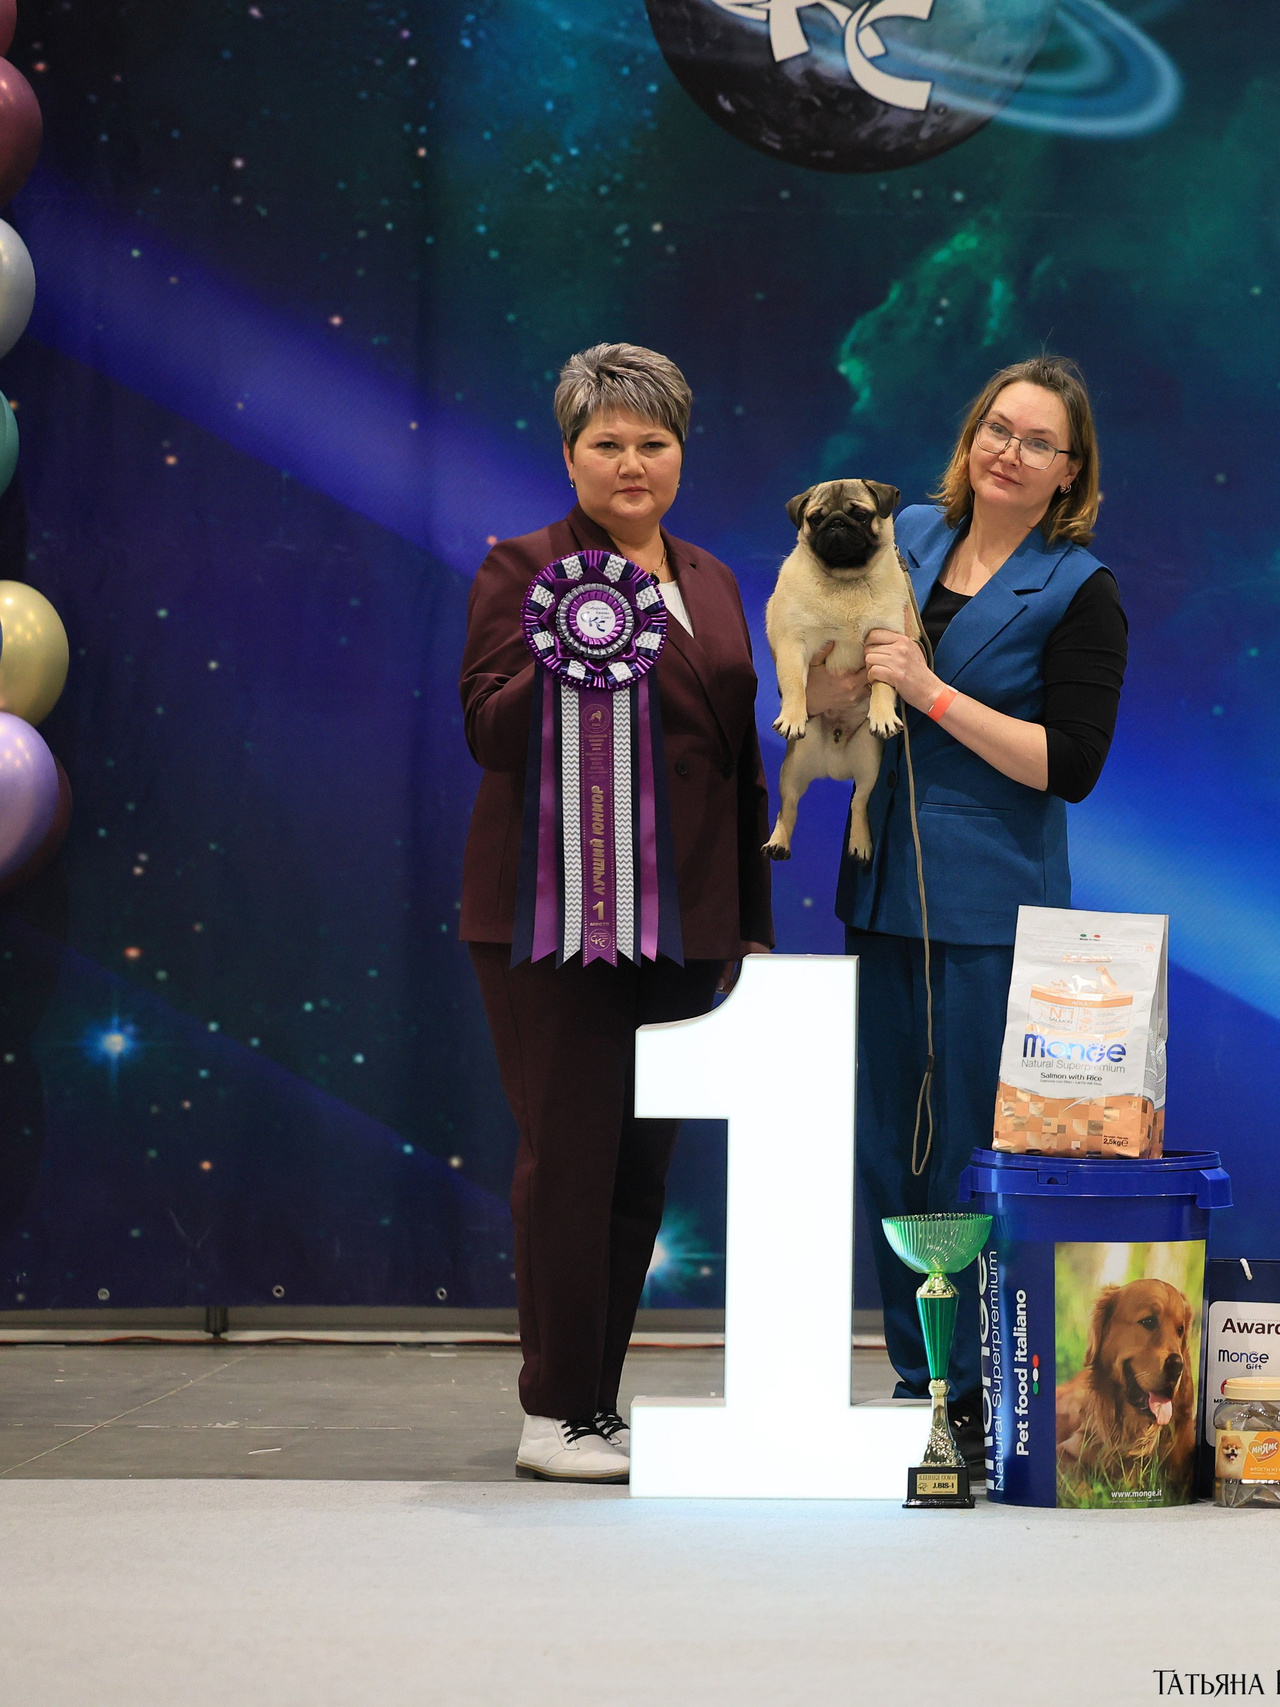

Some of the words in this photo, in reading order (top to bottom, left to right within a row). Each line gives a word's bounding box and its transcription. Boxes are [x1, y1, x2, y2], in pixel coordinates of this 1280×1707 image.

[591, 785, 605, 835] ЮНИОР
[590, 838, 606, 896] ЛУЧШИЙ
[593, 901, 604, 921] 1
[1021, 1059, 1054, 1069] Natural
[1056, 1060, 1126, 1074] Superpremium
[1040, 1072, 1067, 1080] Salmon
[1068, 1073, 1085, 1081] with
[1086, 1074, 1103, 1082] Rice
[629, 953, 932, 1500] 1
[988, 1250, 1005, 1408] Superpremium
[1013, 1289, 1028, 1363] italiano
[1014, 1364, 1029, 1415] food
[992, 1414, 1005, 1492] Natural
[1016, 1419, 1030, 1456] Pet
[1252, 1442, 1279, 1455] МНЯМС
[1111, 1488, 1162, 1499] www.monge.it
